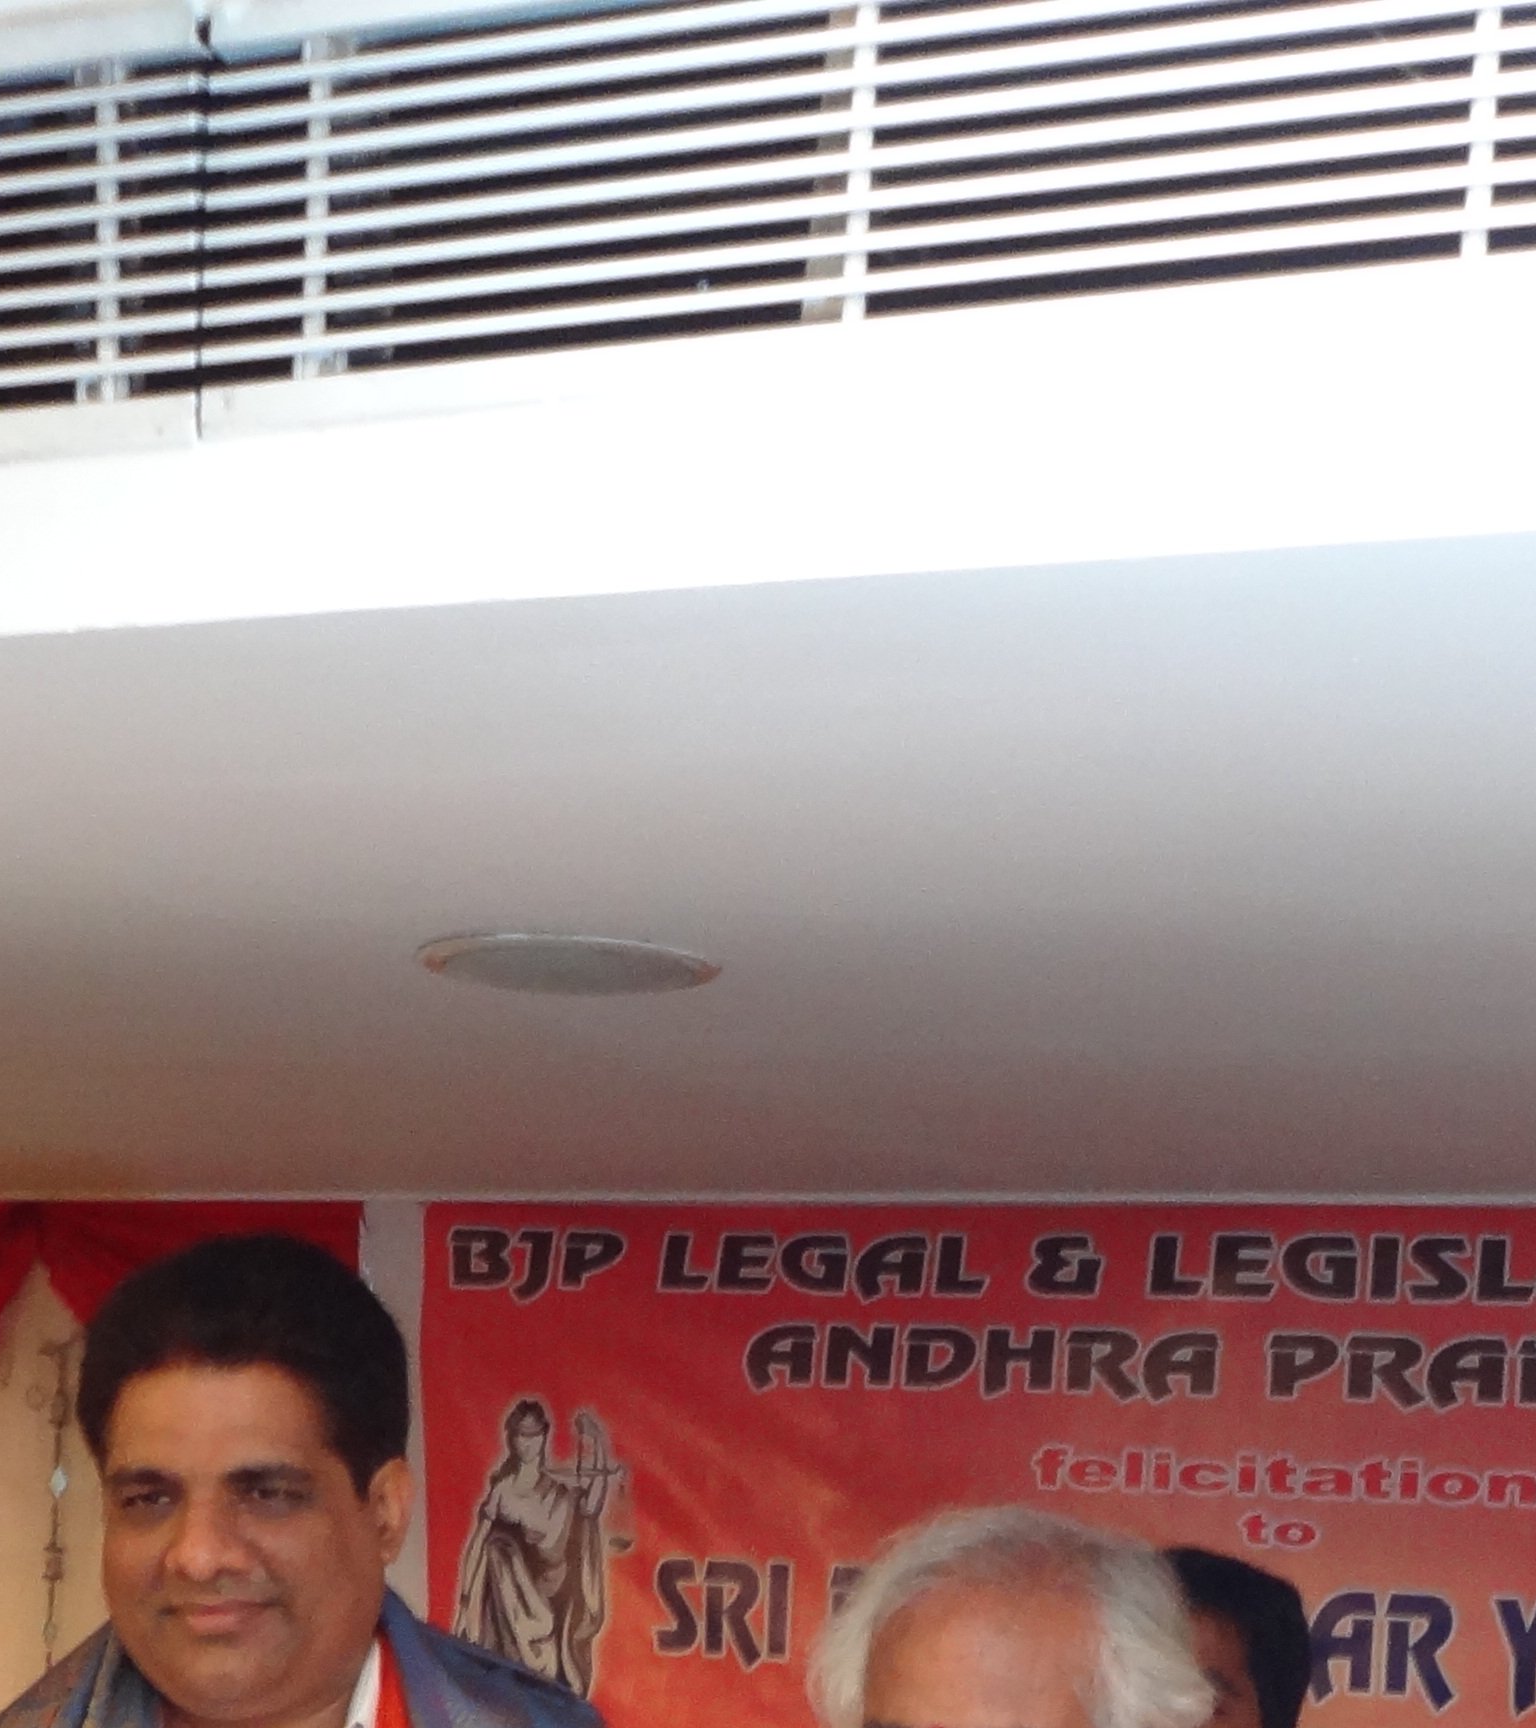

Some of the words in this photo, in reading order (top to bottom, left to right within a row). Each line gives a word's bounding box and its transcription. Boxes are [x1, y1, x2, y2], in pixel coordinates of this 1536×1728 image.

[449, 1228, 625, 1301] BJP
[661, 1234, 987, 1301] LEGAL
[1028, 1234, 1104, 1297] &
[747, 1324, 1220, 1400] ANDHRA
[1240, 1514, 1317, 1549] to
[655, 1558, 790, 1668] SRI
